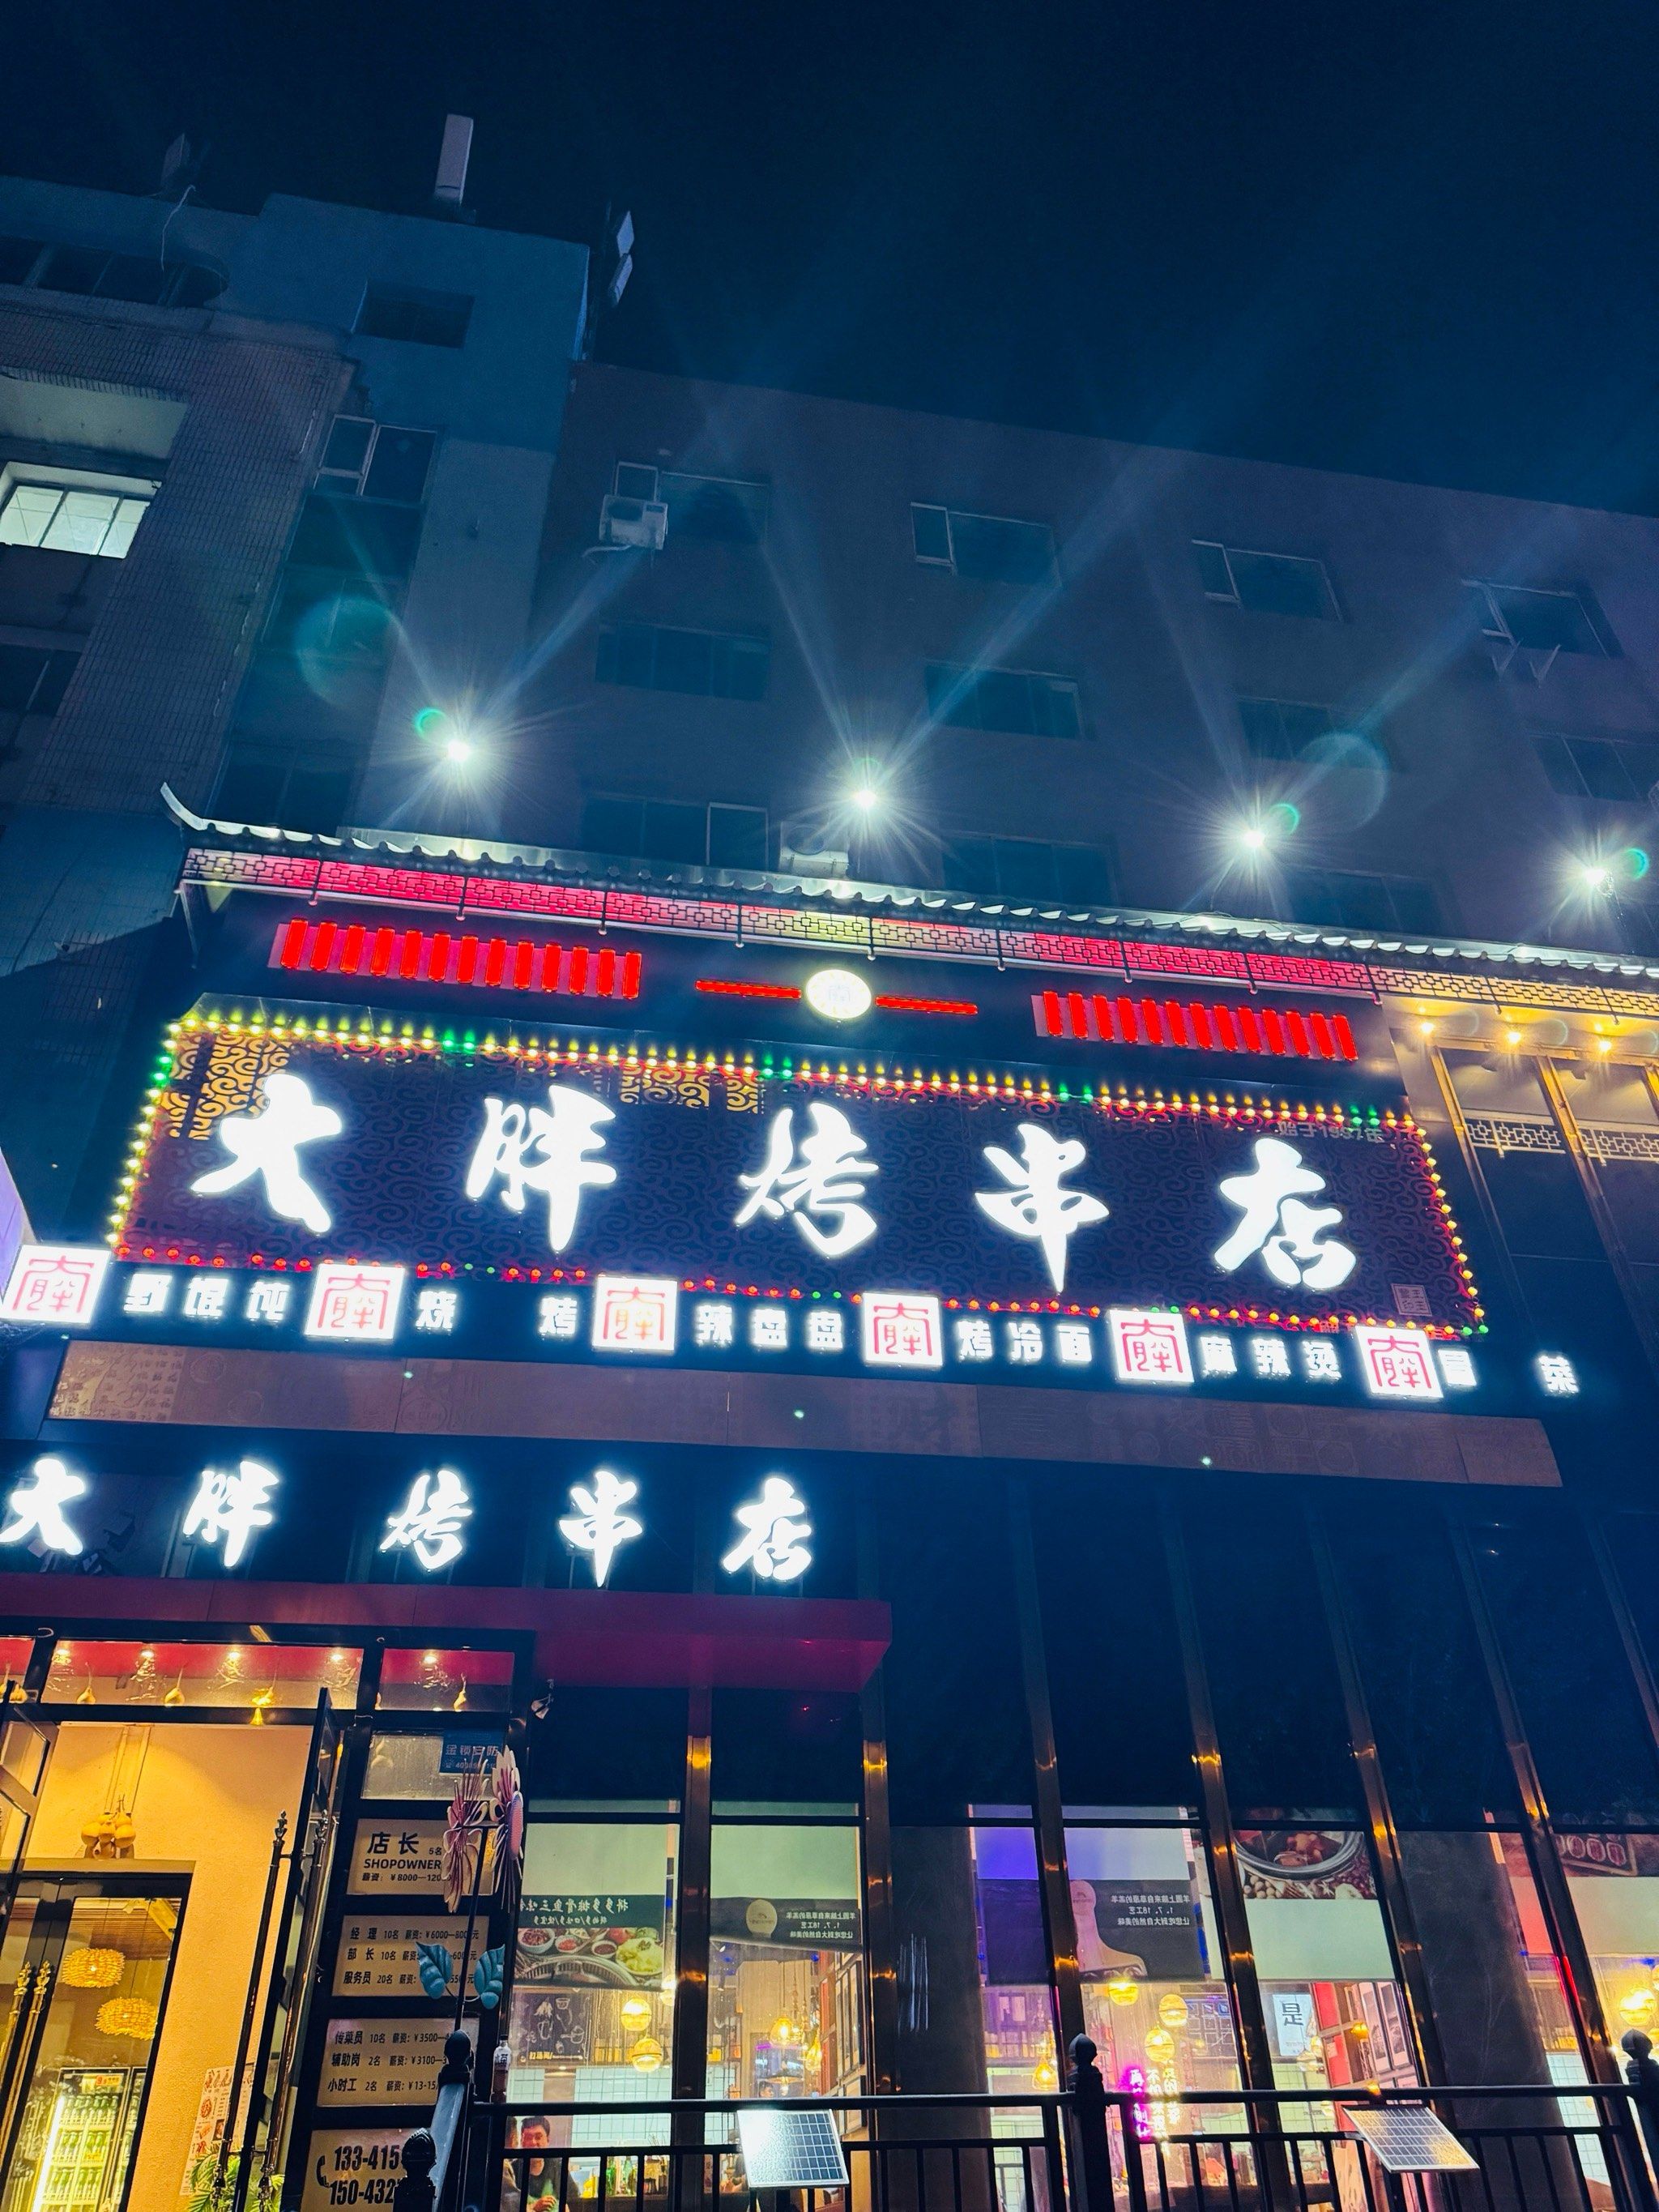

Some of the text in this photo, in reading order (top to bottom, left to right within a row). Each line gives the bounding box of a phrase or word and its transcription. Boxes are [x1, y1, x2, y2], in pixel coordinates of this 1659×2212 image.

[191, 1074, 1355, 1293] 大胖烤串店
[124, 1274, 289, 1321] 野馄饨
[957, 1321, 1092, 1362] 烤冷面
[1201, 1336, 1341, 1377] 麻辣烫
[0, 1458, 811, 1586] 大胖烤串店
[364, 1859, 441, 1869] SHOPOWNER
[343, 1971, 371, 1984] 服务员
[1282, 2002, 1303, 2026] 是
[335, 2031, 363, 2044] 传菜员
[331, 2052, 360, 2066] 辅助岗
[328, 2078, 357, 2091] 小时工
[331, 2178, 401, 2206] 150-432
